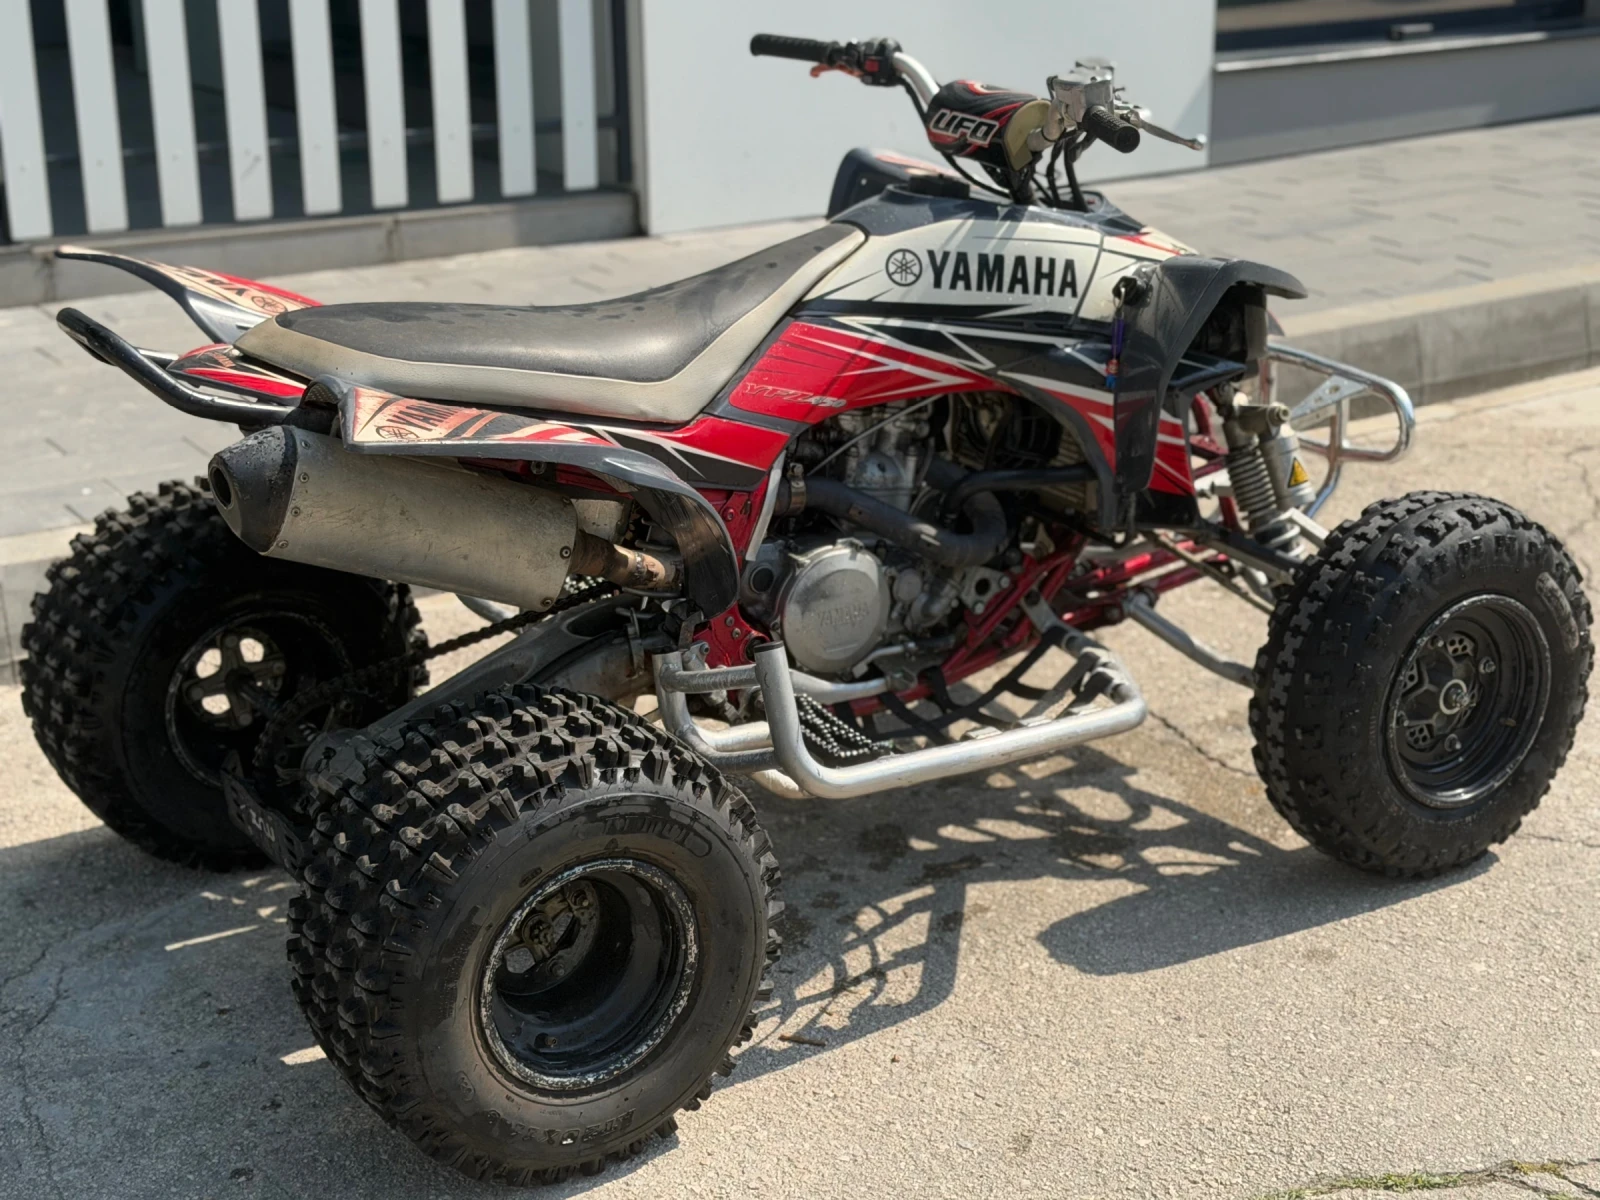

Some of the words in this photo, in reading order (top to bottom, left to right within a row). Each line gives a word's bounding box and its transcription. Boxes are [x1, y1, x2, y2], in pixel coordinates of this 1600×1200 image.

[931, 111, 998, 143] UFO
[926, 248, 1079, 298] YAMAHA
[816, 601, 870, 627] YAMAHA
